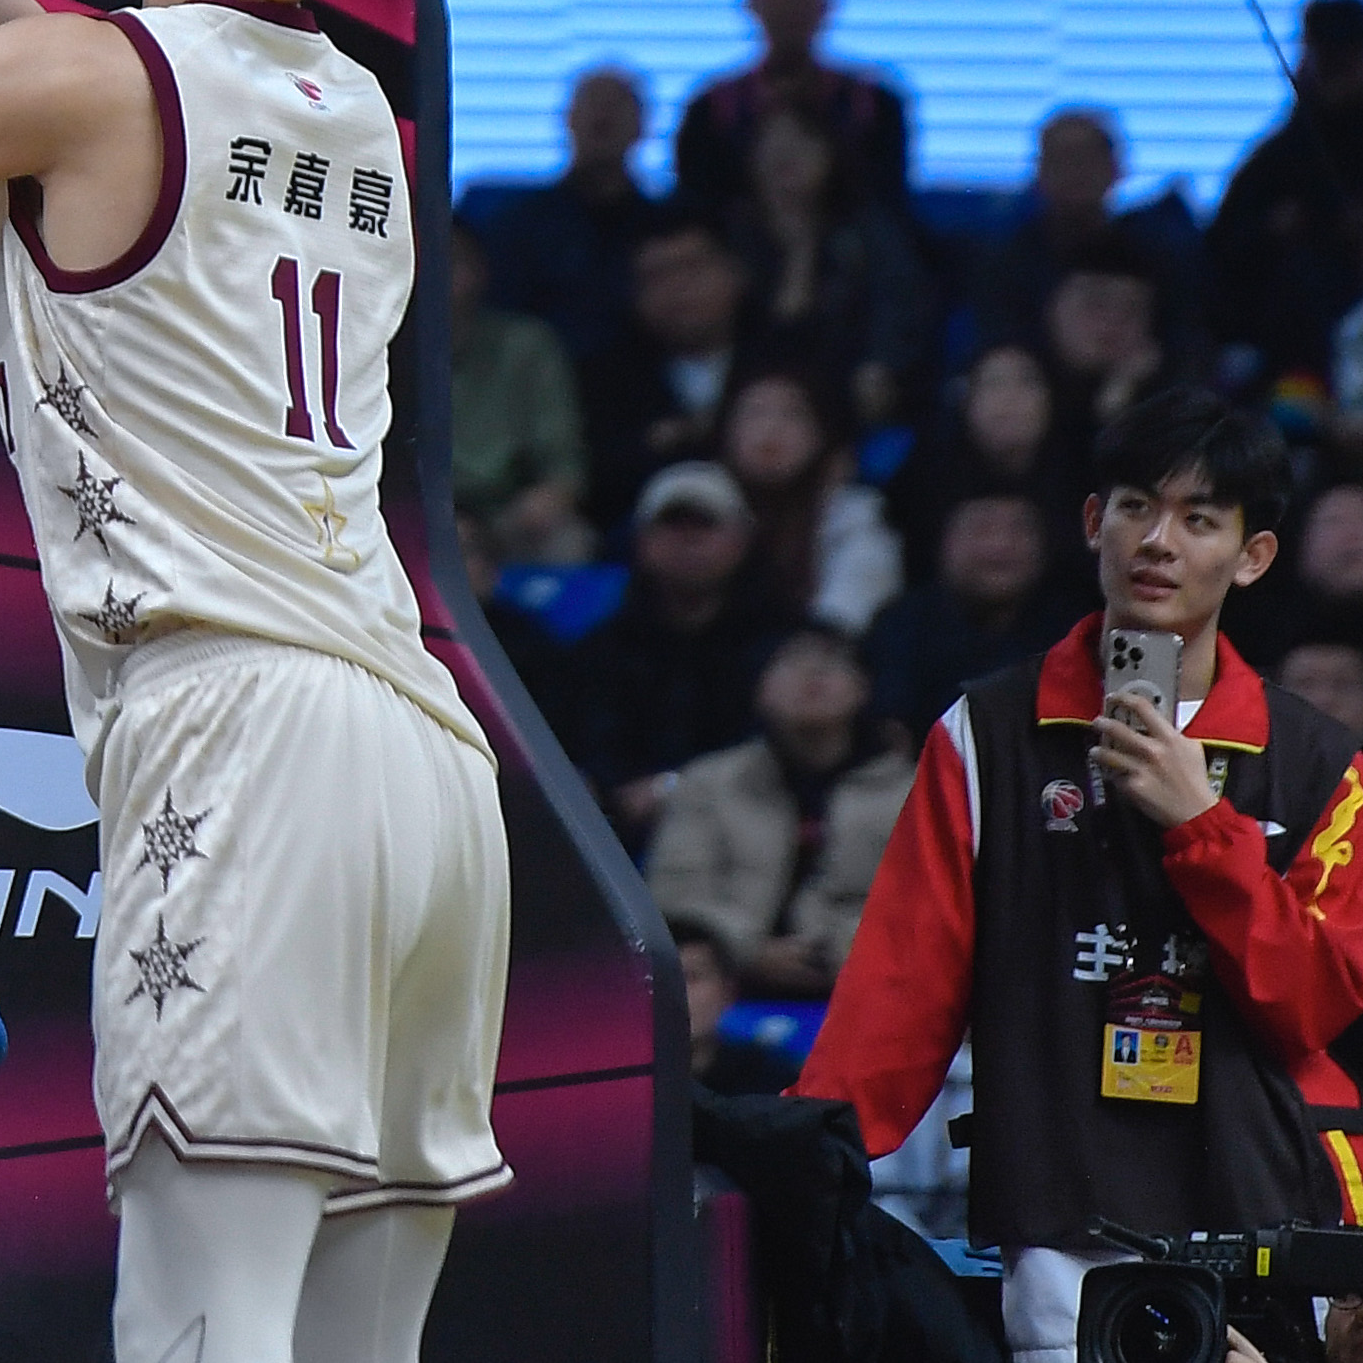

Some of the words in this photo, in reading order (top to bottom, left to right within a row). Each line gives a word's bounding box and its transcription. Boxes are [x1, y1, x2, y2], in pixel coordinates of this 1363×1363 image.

[226, 136, 394, 239] 余嘉豪
[270, 254, 358, 452] 11
